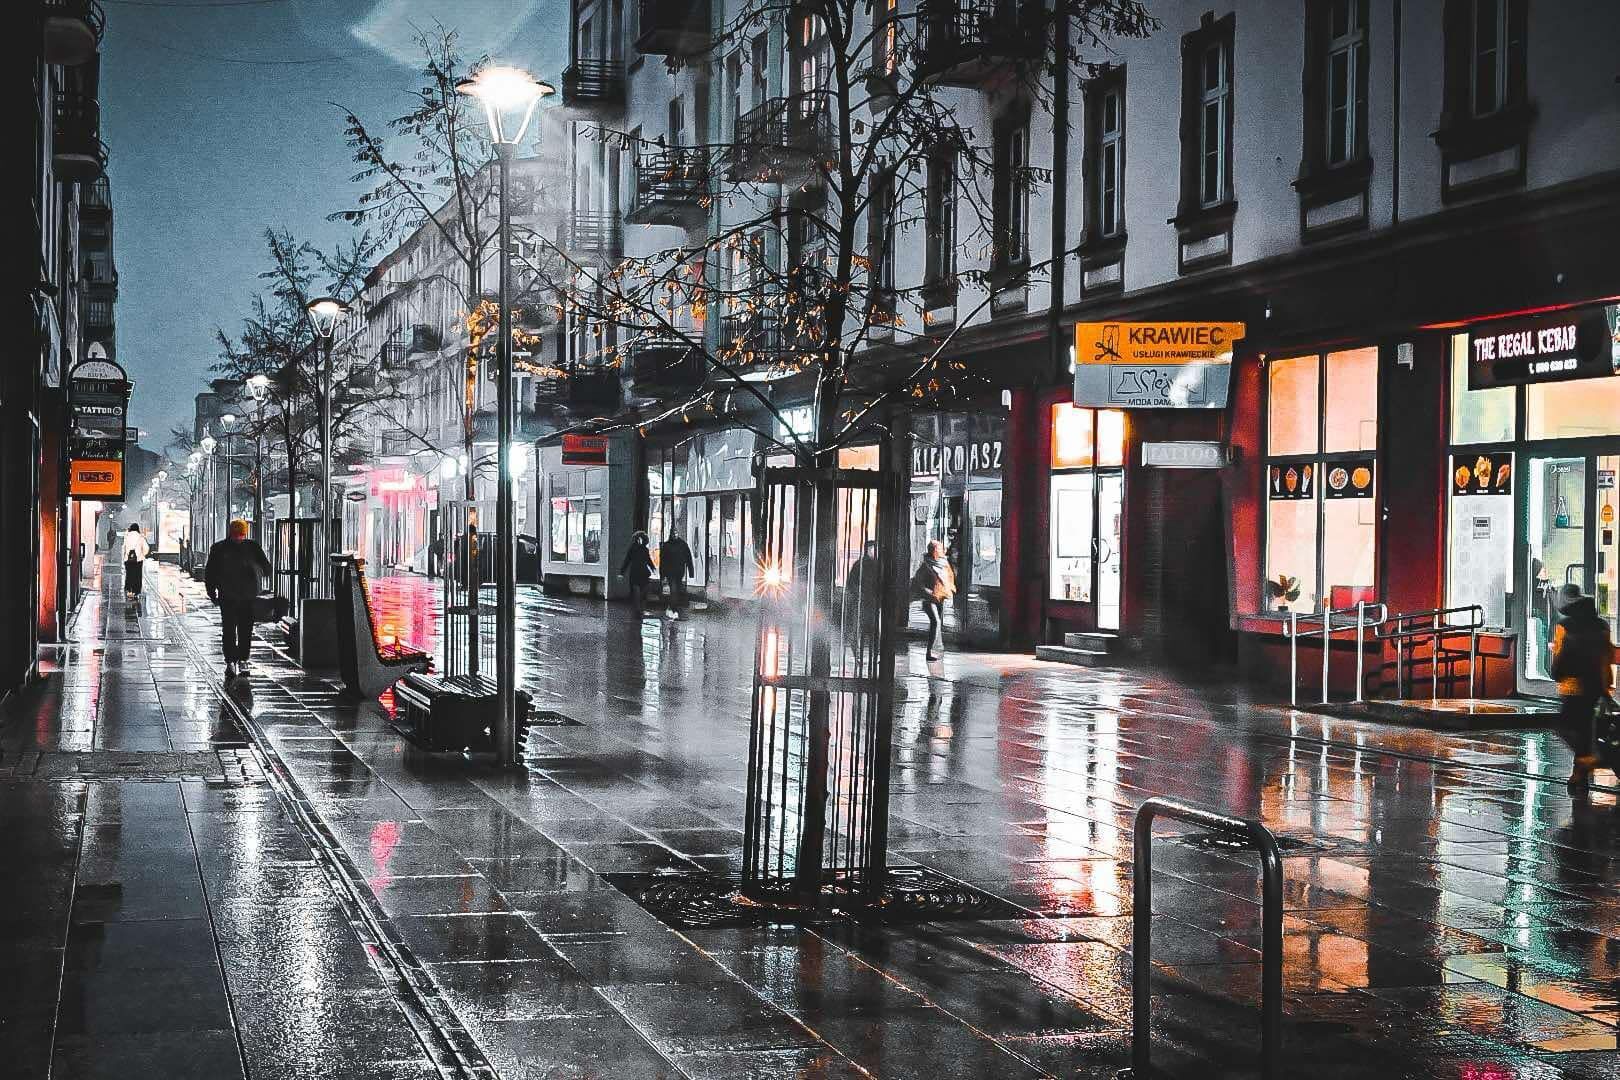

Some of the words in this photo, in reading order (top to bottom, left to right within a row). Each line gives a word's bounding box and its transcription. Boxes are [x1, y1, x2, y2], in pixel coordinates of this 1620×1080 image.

[1128, 326, 1225, 345] KRAWIEC
[1474, 337, 1496, 362] THE
[1497, 330, 1535, 359] REGAL
[1537, 324, 1577, 355] KEBAB
[1133, 350, 1164, 359] USŁUGI
[1164, 350, 1216, 359] KRAWIECKIE
[1127, 398, 1151, 406] MODA
[913, 441, 1002, 477] KIERMASZ
